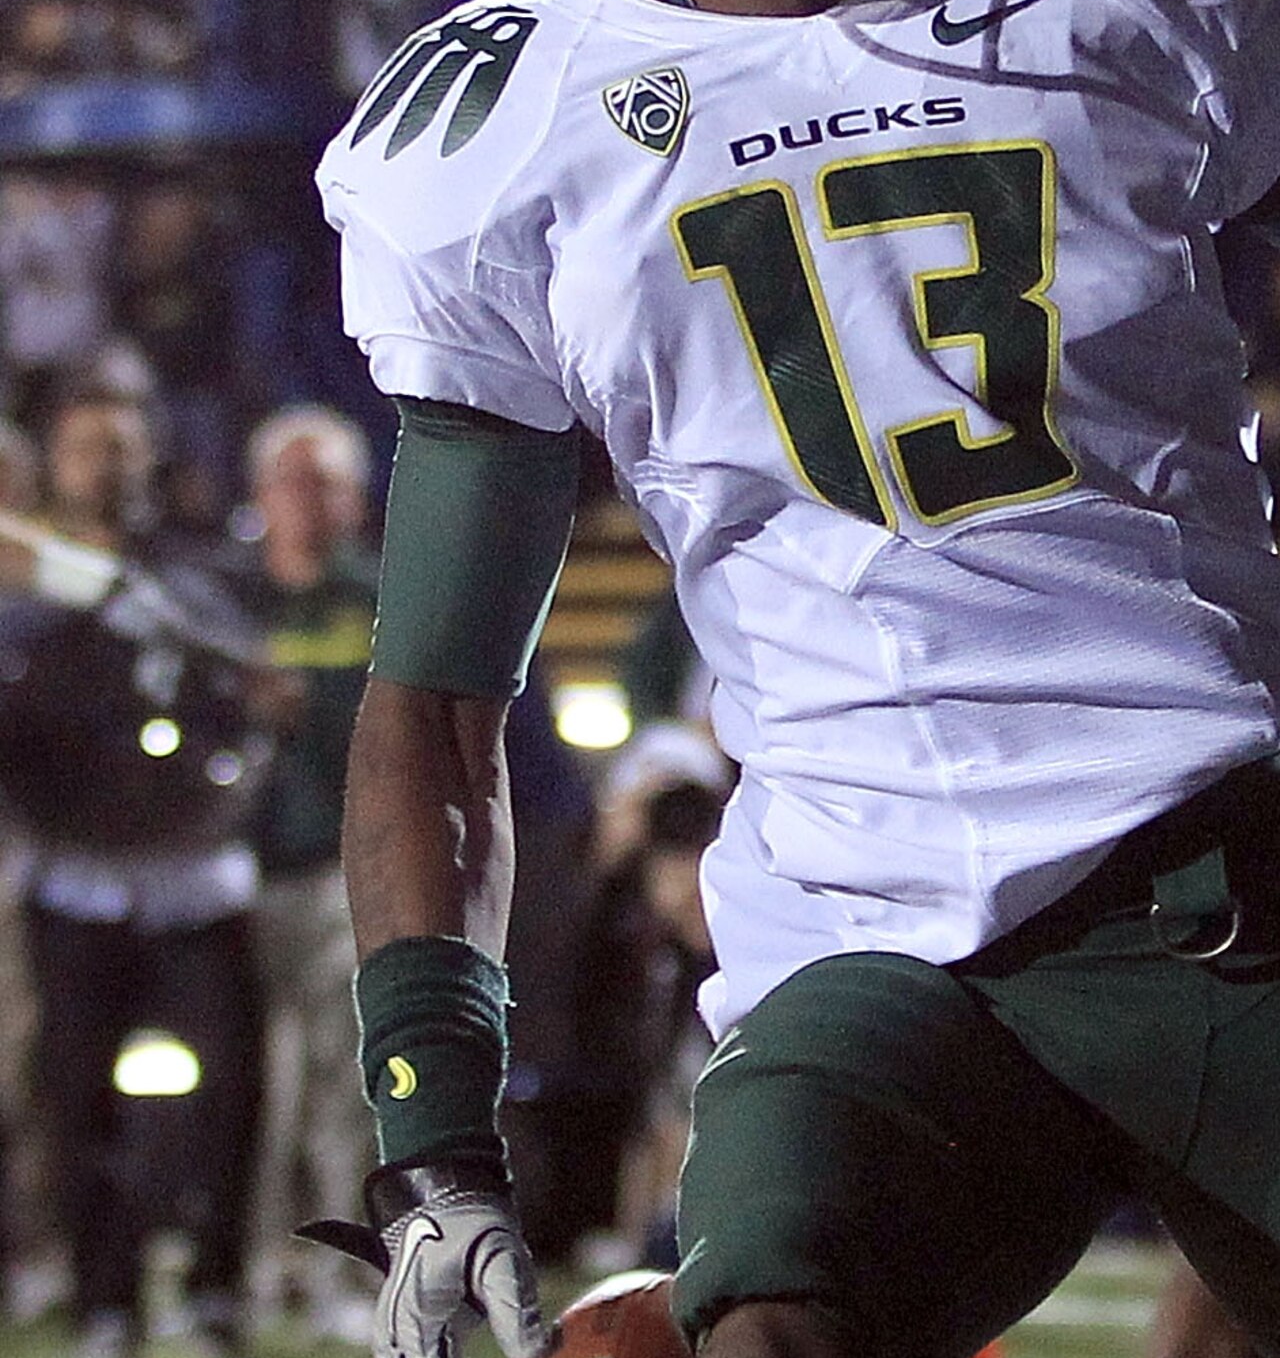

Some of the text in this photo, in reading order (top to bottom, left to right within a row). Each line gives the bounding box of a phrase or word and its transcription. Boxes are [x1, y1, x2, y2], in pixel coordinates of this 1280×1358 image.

[604, 70, 683, 131] PAC
[631, 103, 676, 143] 10
[729, 97, 967, 167] DUCKS
[669, 139, 1081, 533] 13
